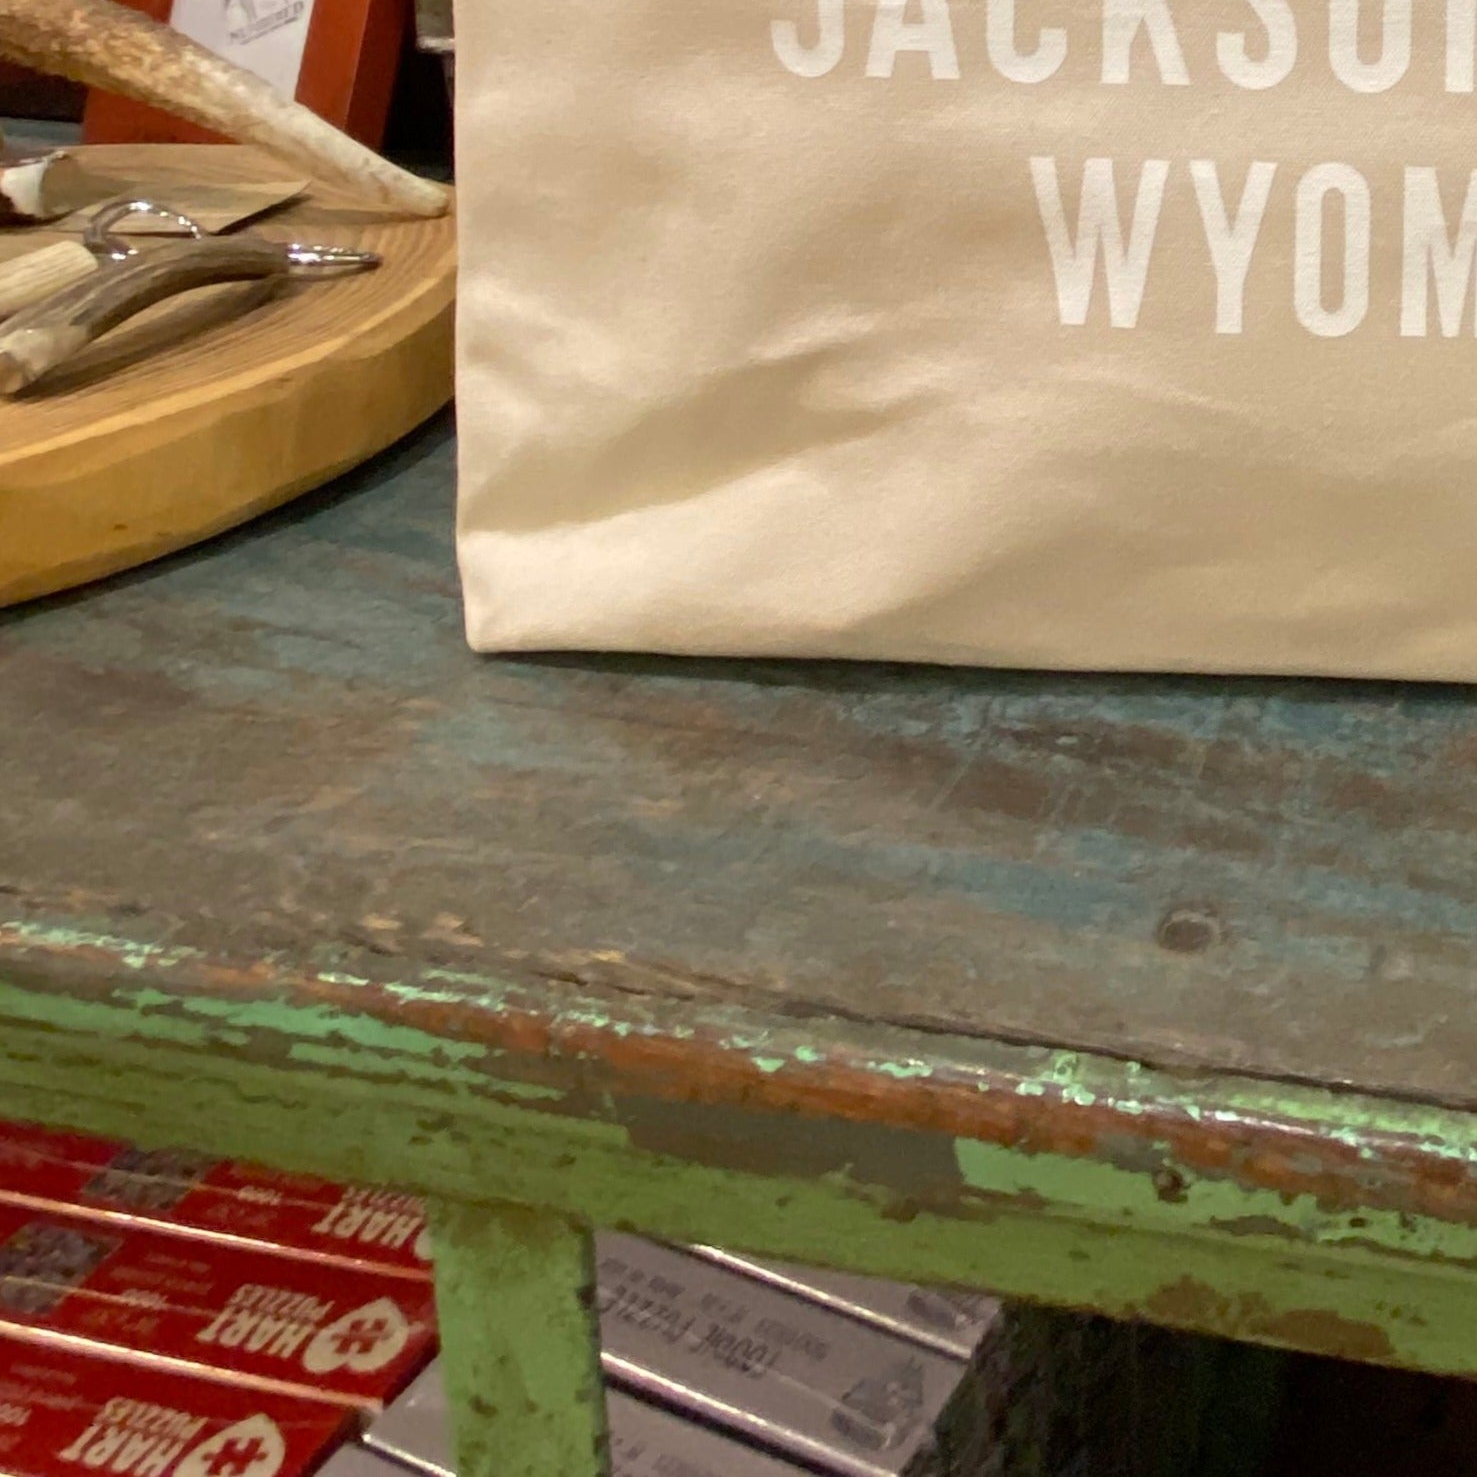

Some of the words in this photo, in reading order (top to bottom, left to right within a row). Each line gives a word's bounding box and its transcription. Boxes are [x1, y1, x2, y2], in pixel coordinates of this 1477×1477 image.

[310, 1201, 424, 1249] HART
[227, 1284, 336, 1323] PUZZLES
[196, 1305, 316, 1360] HART
[94, 1396, 209, 1440] PUZZLES
[58, 1422, 188, 1477] HART
